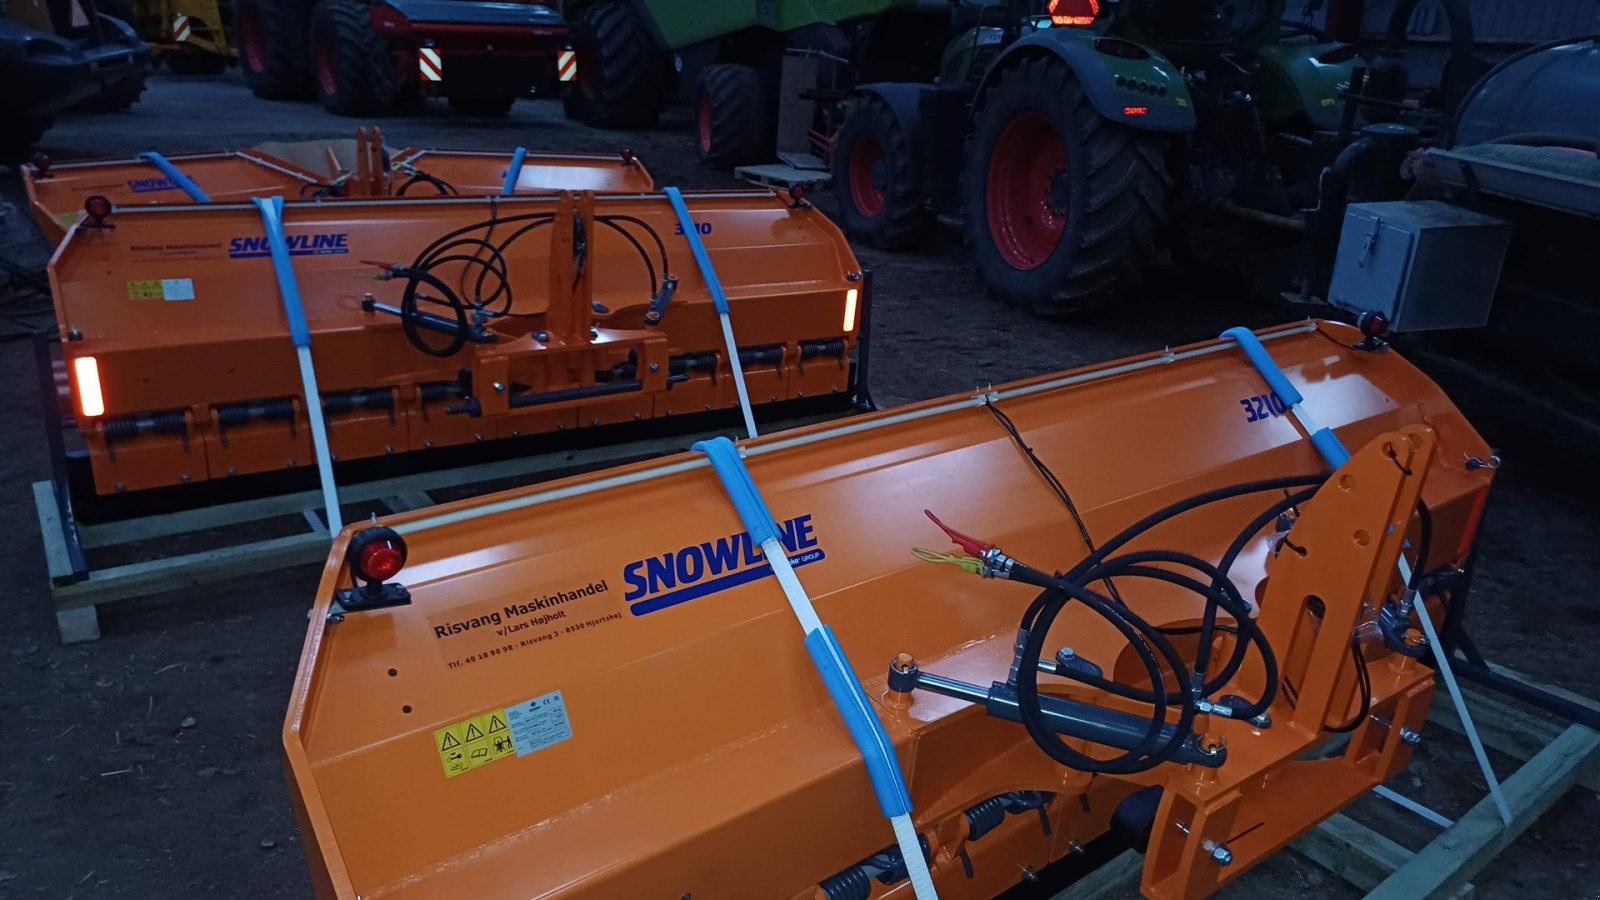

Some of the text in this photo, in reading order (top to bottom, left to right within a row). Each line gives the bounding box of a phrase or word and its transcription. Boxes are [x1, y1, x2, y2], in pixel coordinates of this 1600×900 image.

[1240, 391, 1287, 423] 3210
[624, 514, 817, 601] SNOWLNE
[801, 552, 820, 562] GROUP
[434, 579, 609, 639] Risvang Maskinhandel
[496, 610, 567, 637] v/Lars Højholt
[465, 656, 476, 664] 40
[478, 652, 489, 660] 18
[490, 648, 501, 656] 90
[502, 644, 514, 653] 98
[520, 633, 553, 648] Risvang
[565, 623, 585, 634] 8530
[586, 611, 622, 628] Hjortshøj
